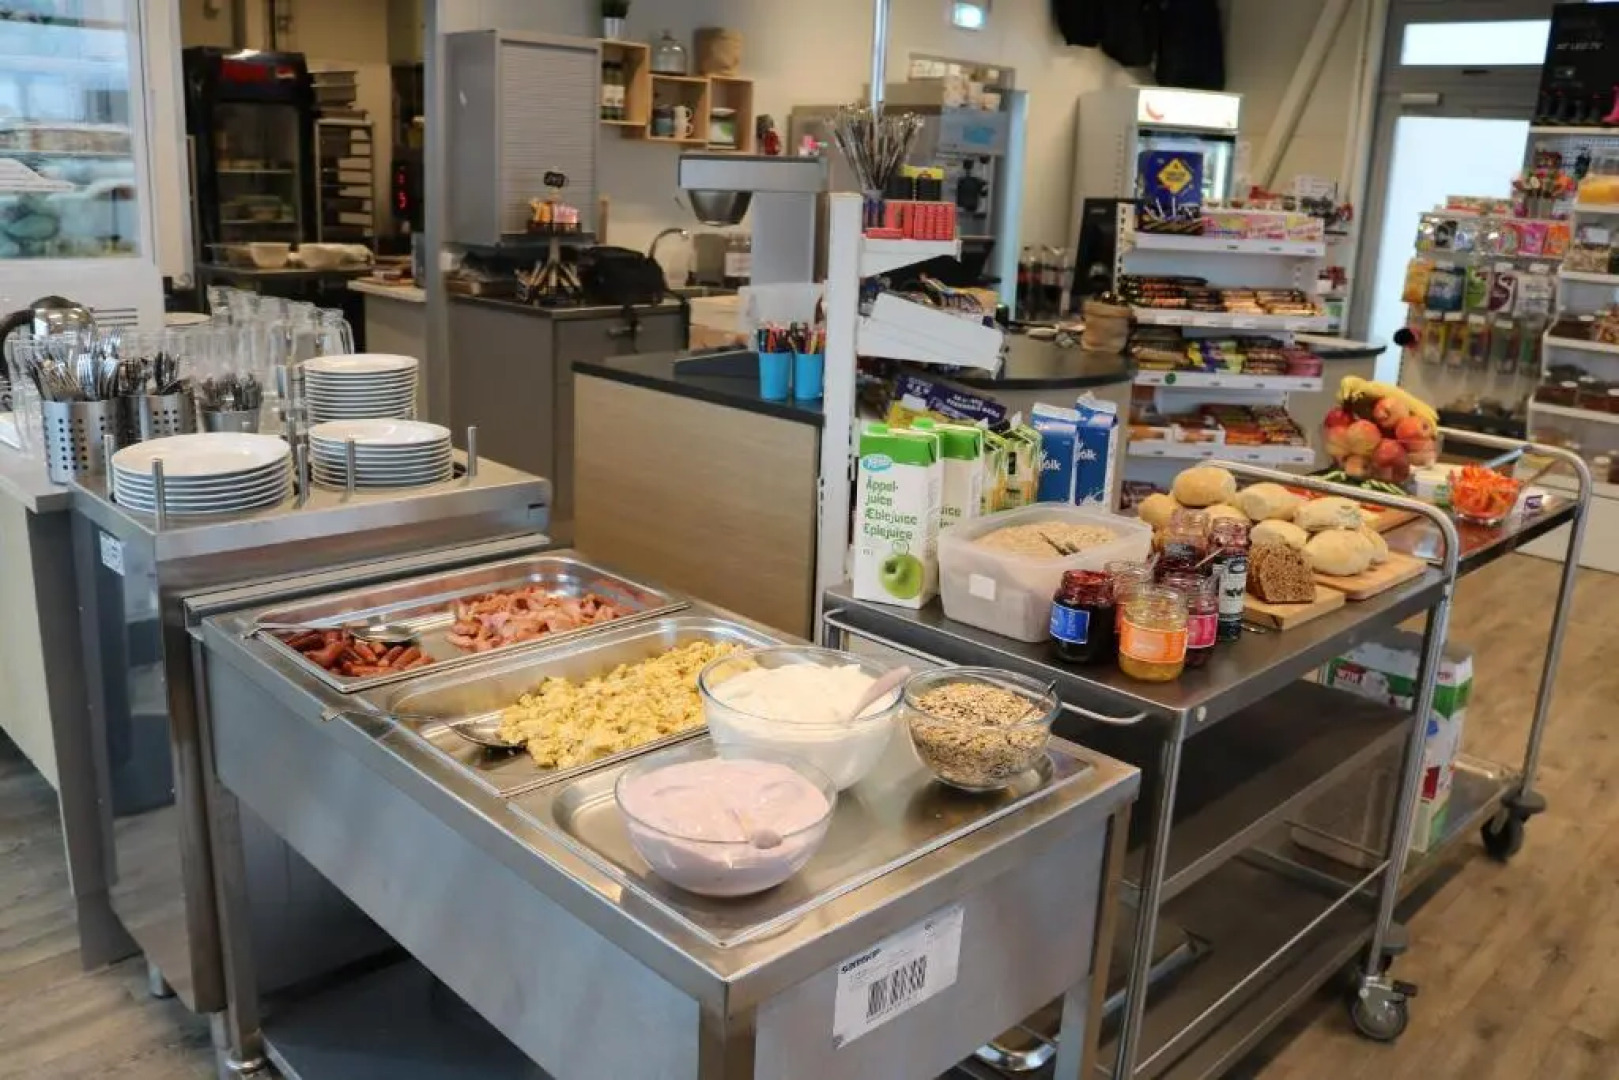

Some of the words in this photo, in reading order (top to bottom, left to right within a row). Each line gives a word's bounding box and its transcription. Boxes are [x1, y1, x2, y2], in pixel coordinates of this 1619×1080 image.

[866, 476, 899, 493] Äppel-
[865, 493, 893, 507] juice
[864, 507, 918, 526] Æblejuice
[863, 523, 913, 540] Eplejuice
